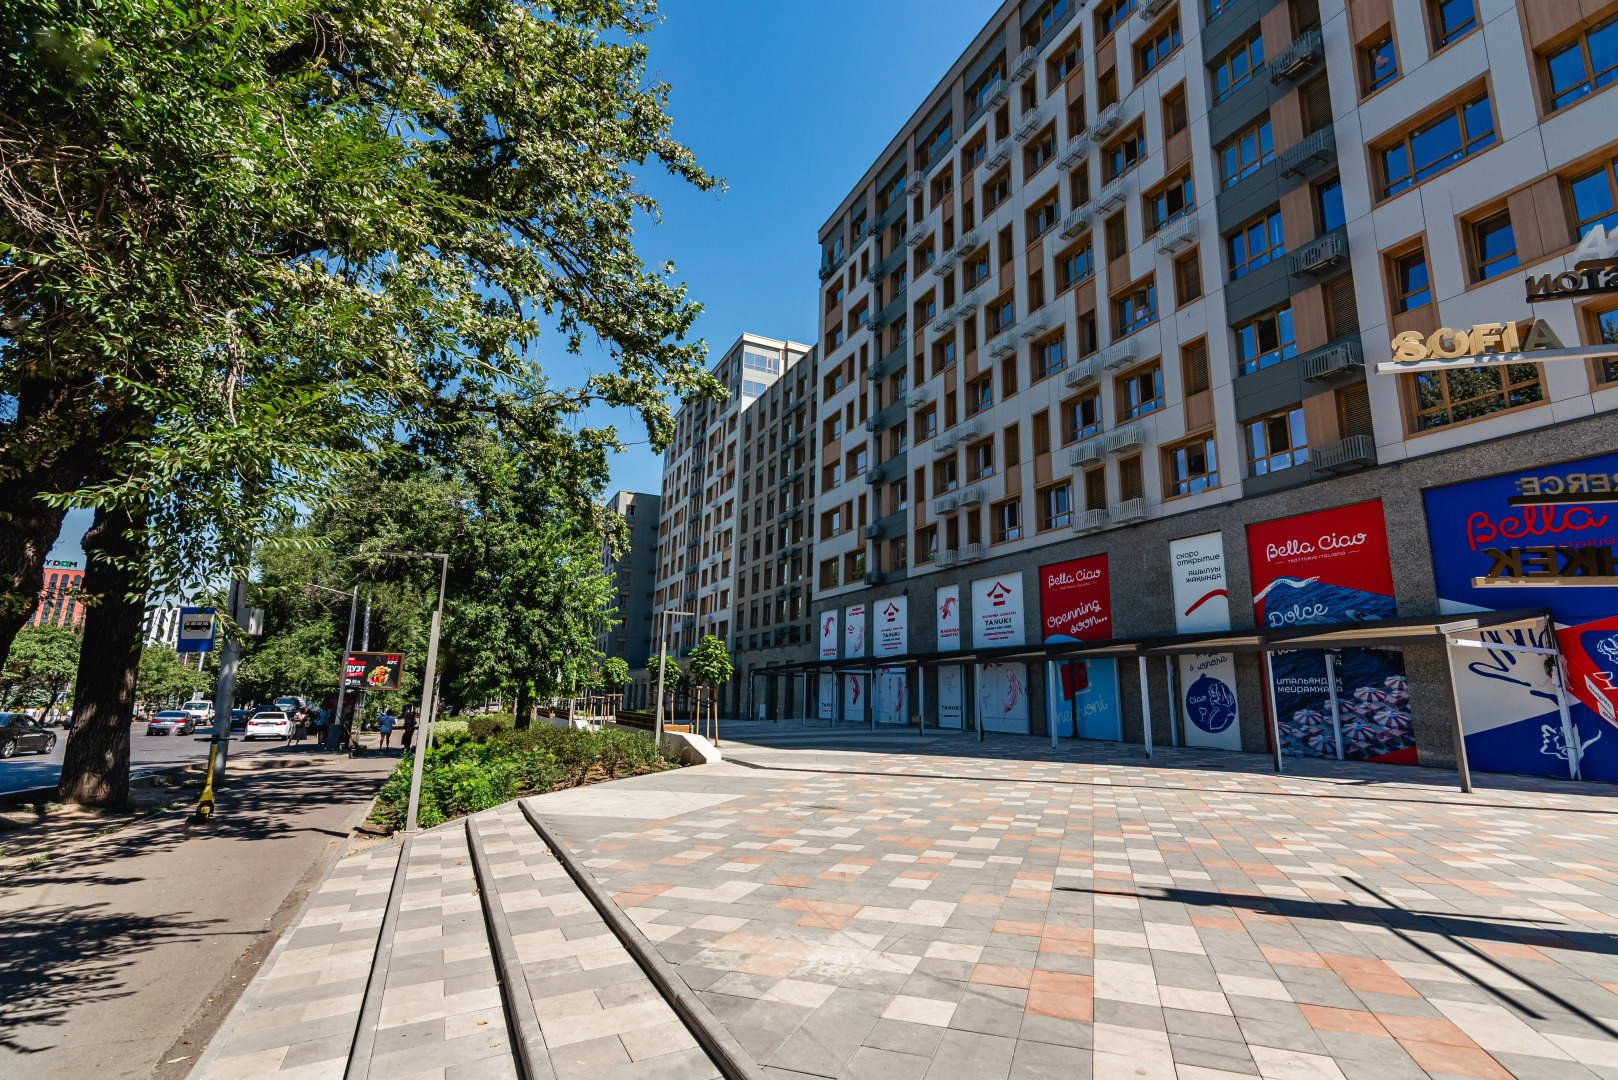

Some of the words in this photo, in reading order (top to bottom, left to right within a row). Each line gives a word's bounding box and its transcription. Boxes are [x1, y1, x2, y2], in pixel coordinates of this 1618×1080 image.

[1391, 318, 1566, 363] SOFIA
[1466, 504, 1608, 551] Bella
[1266, 539, 1315, 562] Bella
[1318, 532, 1367, 550] Ciao
[1048, 572, 1074, 589] Bella
[1075, 568, 1102, 581] Ciao
[985, 617, 1012, 626] TANUKI
[1047, 600, 1102, 628] Openning
[1269, 603, 1328, 628] Dolce
[346, 665, 366, 673] ДУЭТ
[1276, 677, 1343, 686] итальяндқ
[1277, 684, 1343, 694] мейрамхаа
[1056, 694, 1108, 725] neroni
